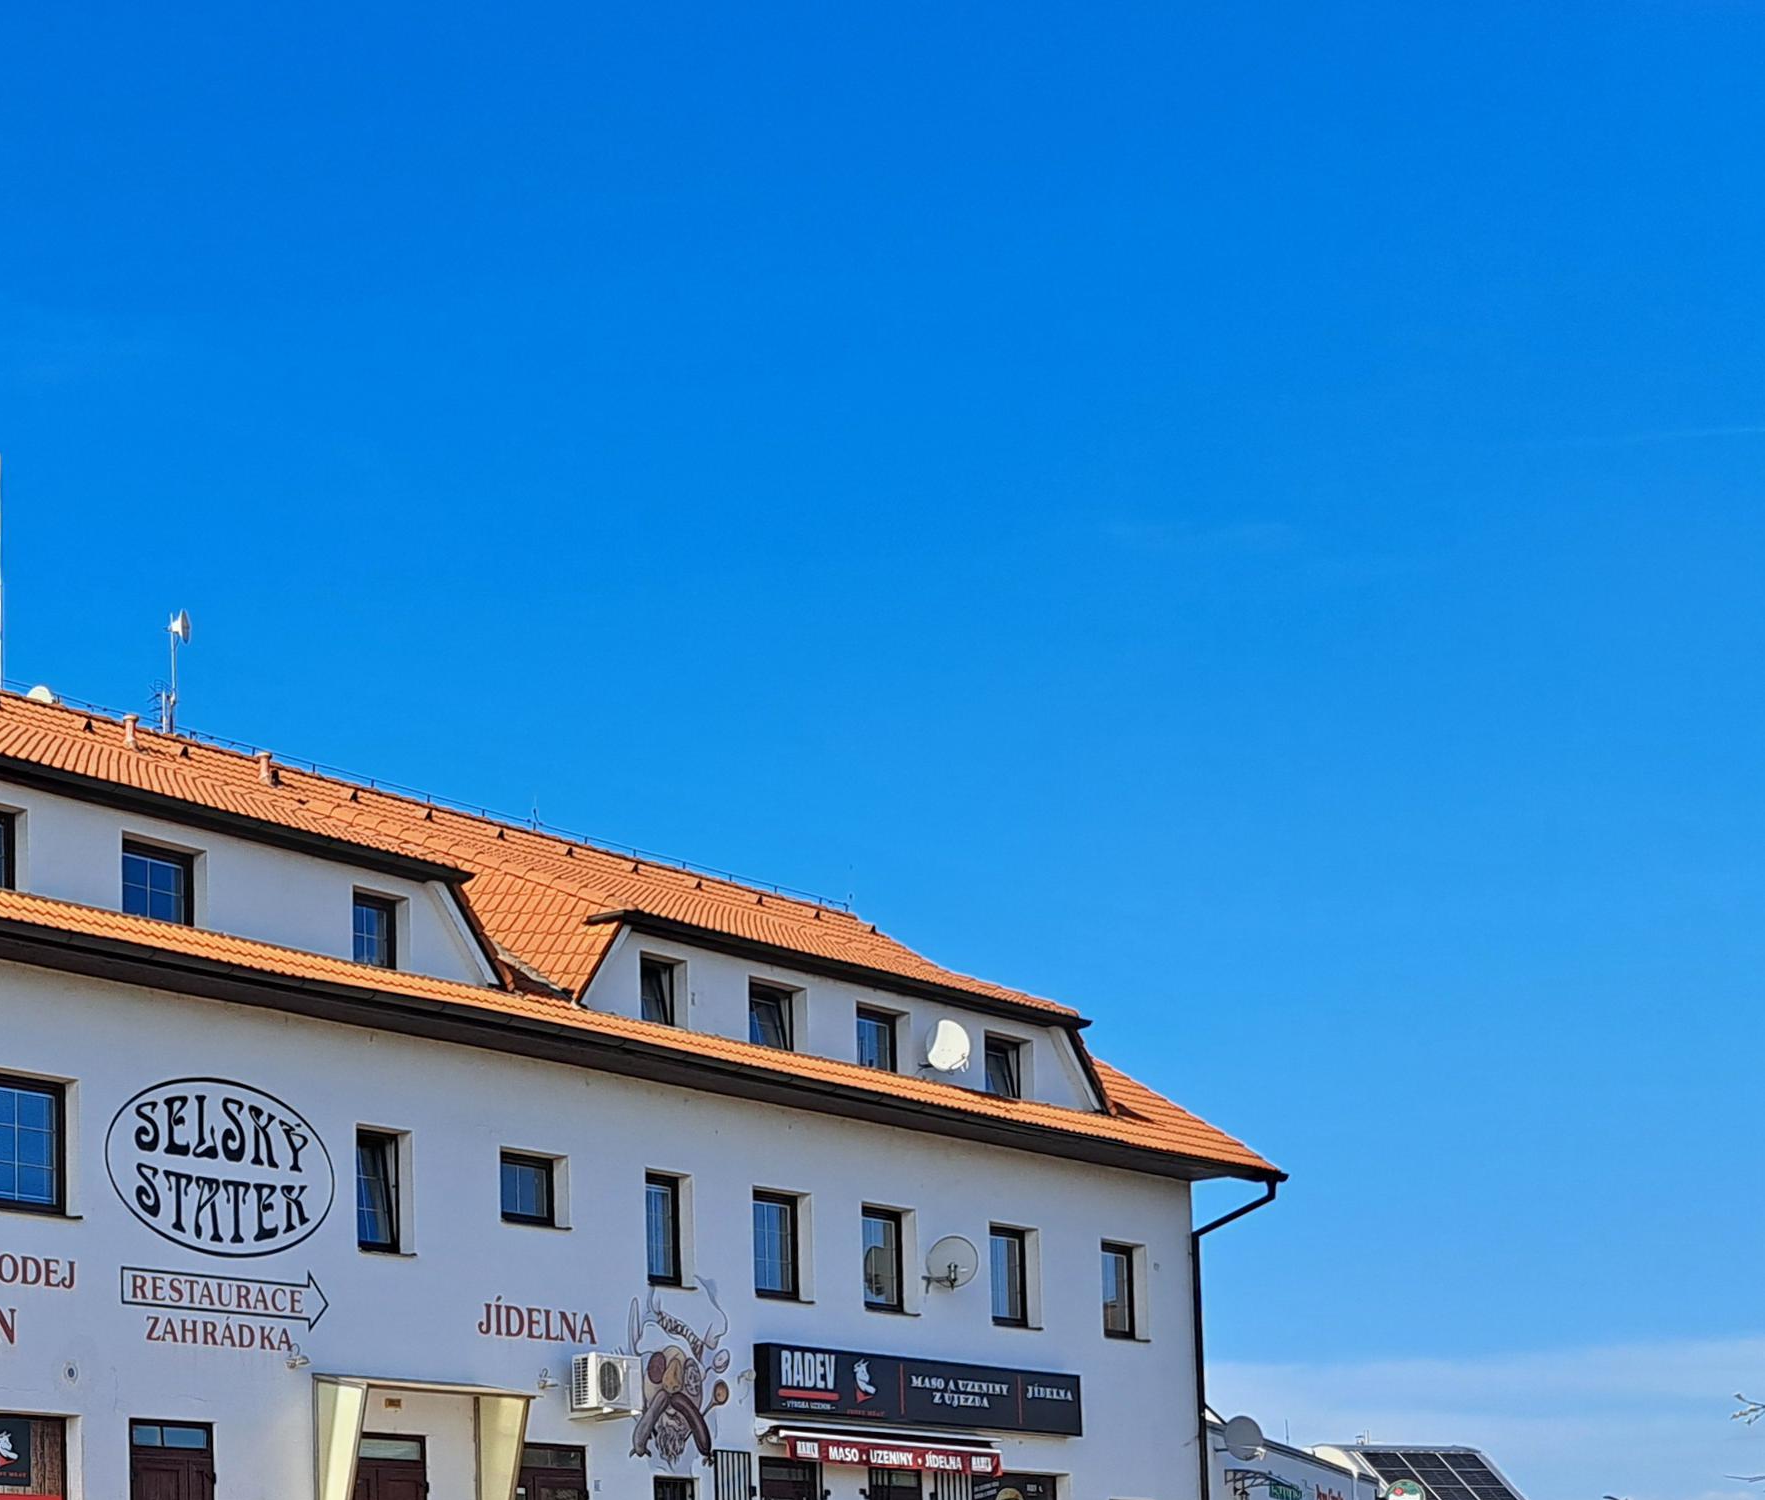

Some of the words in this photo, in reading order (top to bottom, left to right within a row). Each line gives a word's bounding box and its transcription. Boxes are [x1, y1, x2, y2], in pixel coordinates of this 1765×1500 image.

[135, 1095, 308, 1173] SELSKÝ
[136, 1162, 310, 1243] STATEK
[131, 1274, 304, 1314] RESTAURACE
[146, 1316, 293, 1352] ZAHRÁDKA
[478, 1295, 597, 1344] JÍDELNA
[781, 1350, 835, 1389] RADEV
[911, 1375, 944, 1389] MASO
[947, 1380, 957, 1392] A
[958, 1380, 1009, 1395] UZENINY
[933, 1392, 942, 1403] Z
[945, 1391, 989, 1408] ÚJEZDA
[1026, 1384, 1073, 1401] JÍDELNA
[828, 1446, 859, 1462] MASO
[869, 1449, 913, 1466] UZENINY
[925, 1451, 962, 1470] JÍDELNA
